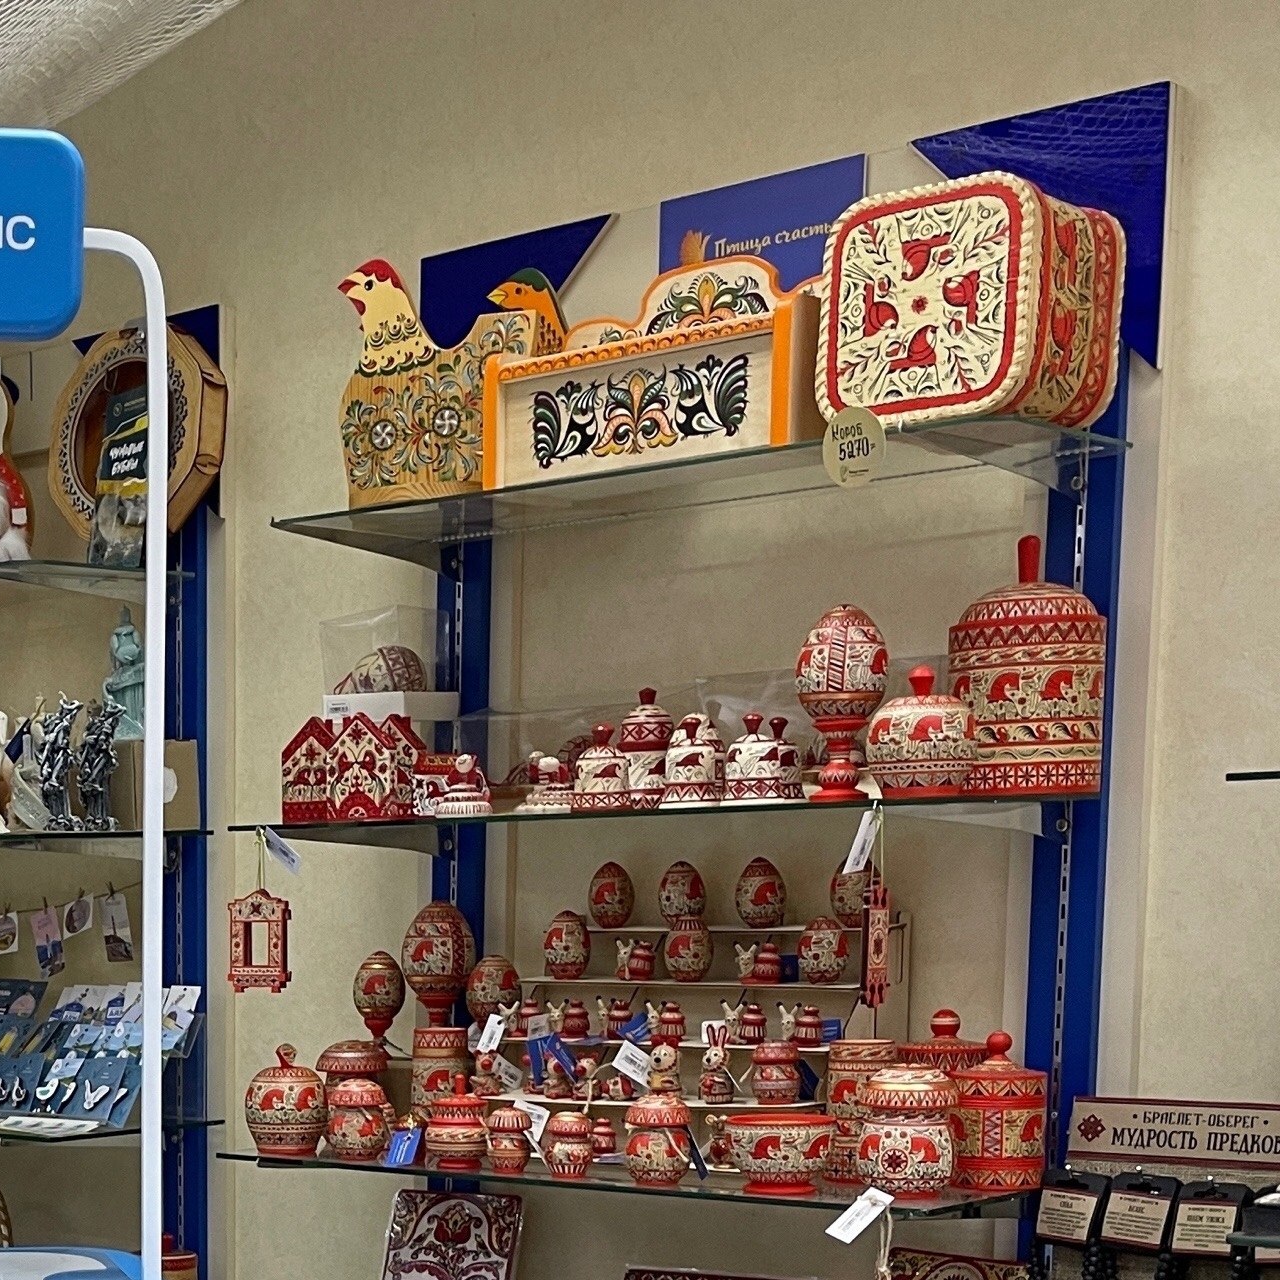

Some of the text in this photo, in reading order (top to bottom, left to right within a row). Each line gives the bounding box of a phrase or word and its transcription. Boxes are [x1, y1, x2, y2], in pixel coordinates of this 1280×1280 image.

[714, 221, 833, 258] Птица счасть
[831, 422, 863, 442] Короб
[1142, 1110, 1260, 1129] БРАСЛЕТ-ОБЕРЕГ
[1111, 1127, 1280, 1155] МУДРОСТЬ ПРЕДКОВ
